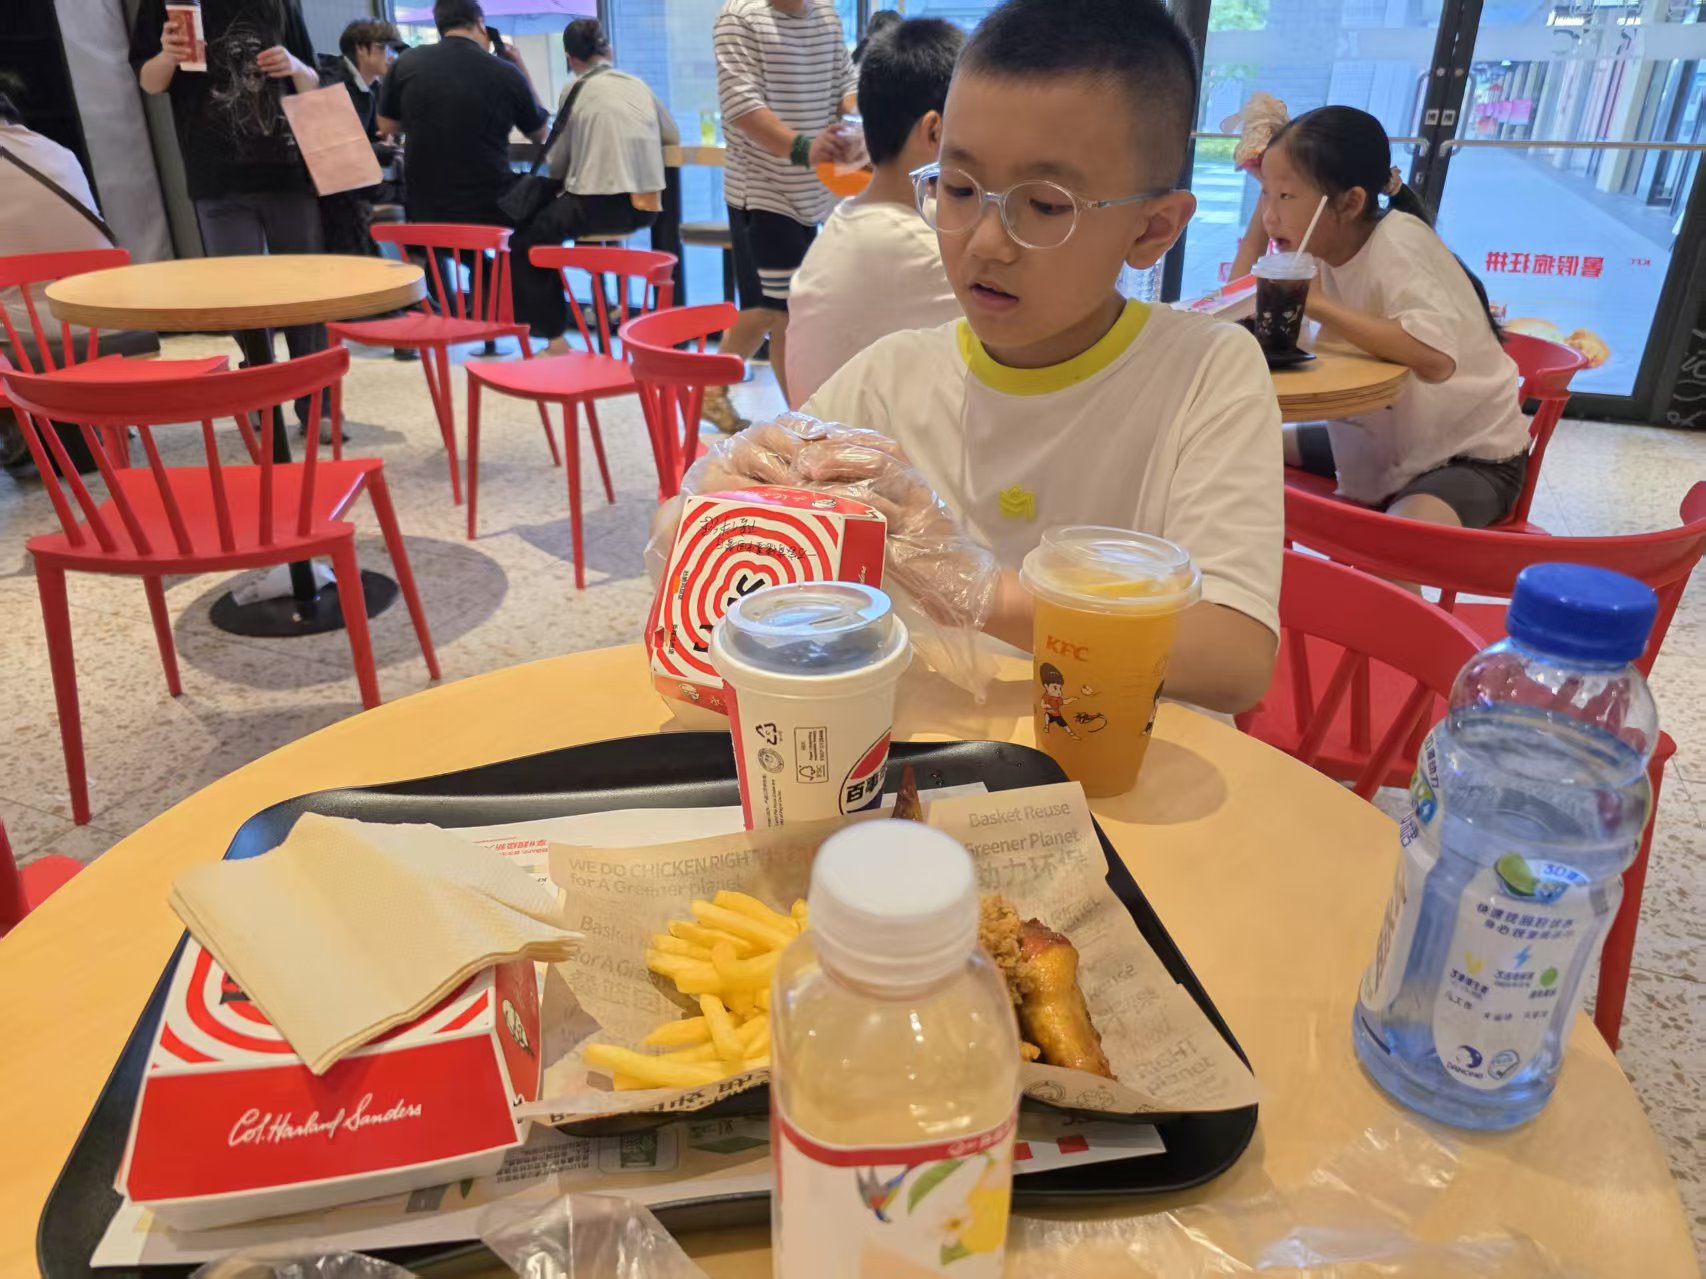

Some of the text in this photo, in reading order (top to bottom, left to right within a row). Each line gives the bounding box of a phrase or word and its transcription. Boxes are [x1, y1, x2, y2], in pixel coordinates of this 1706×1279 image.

[1045, 635, 1089, 662] KFC
[968, 803, 1071, 828] Basket Reuse
[1030, 829, 1081, 849] Planet
[568, 858, 598, 873] WE
[600, 862, 627, 877] DO
[629, 855, 708, 879] CHICKEN
[569, 872, 597, 887] for
[597, 879, 611, 892] A
[613, 879, 685, 898] Greener
[343, 1092, 423, 1131] Sanders
